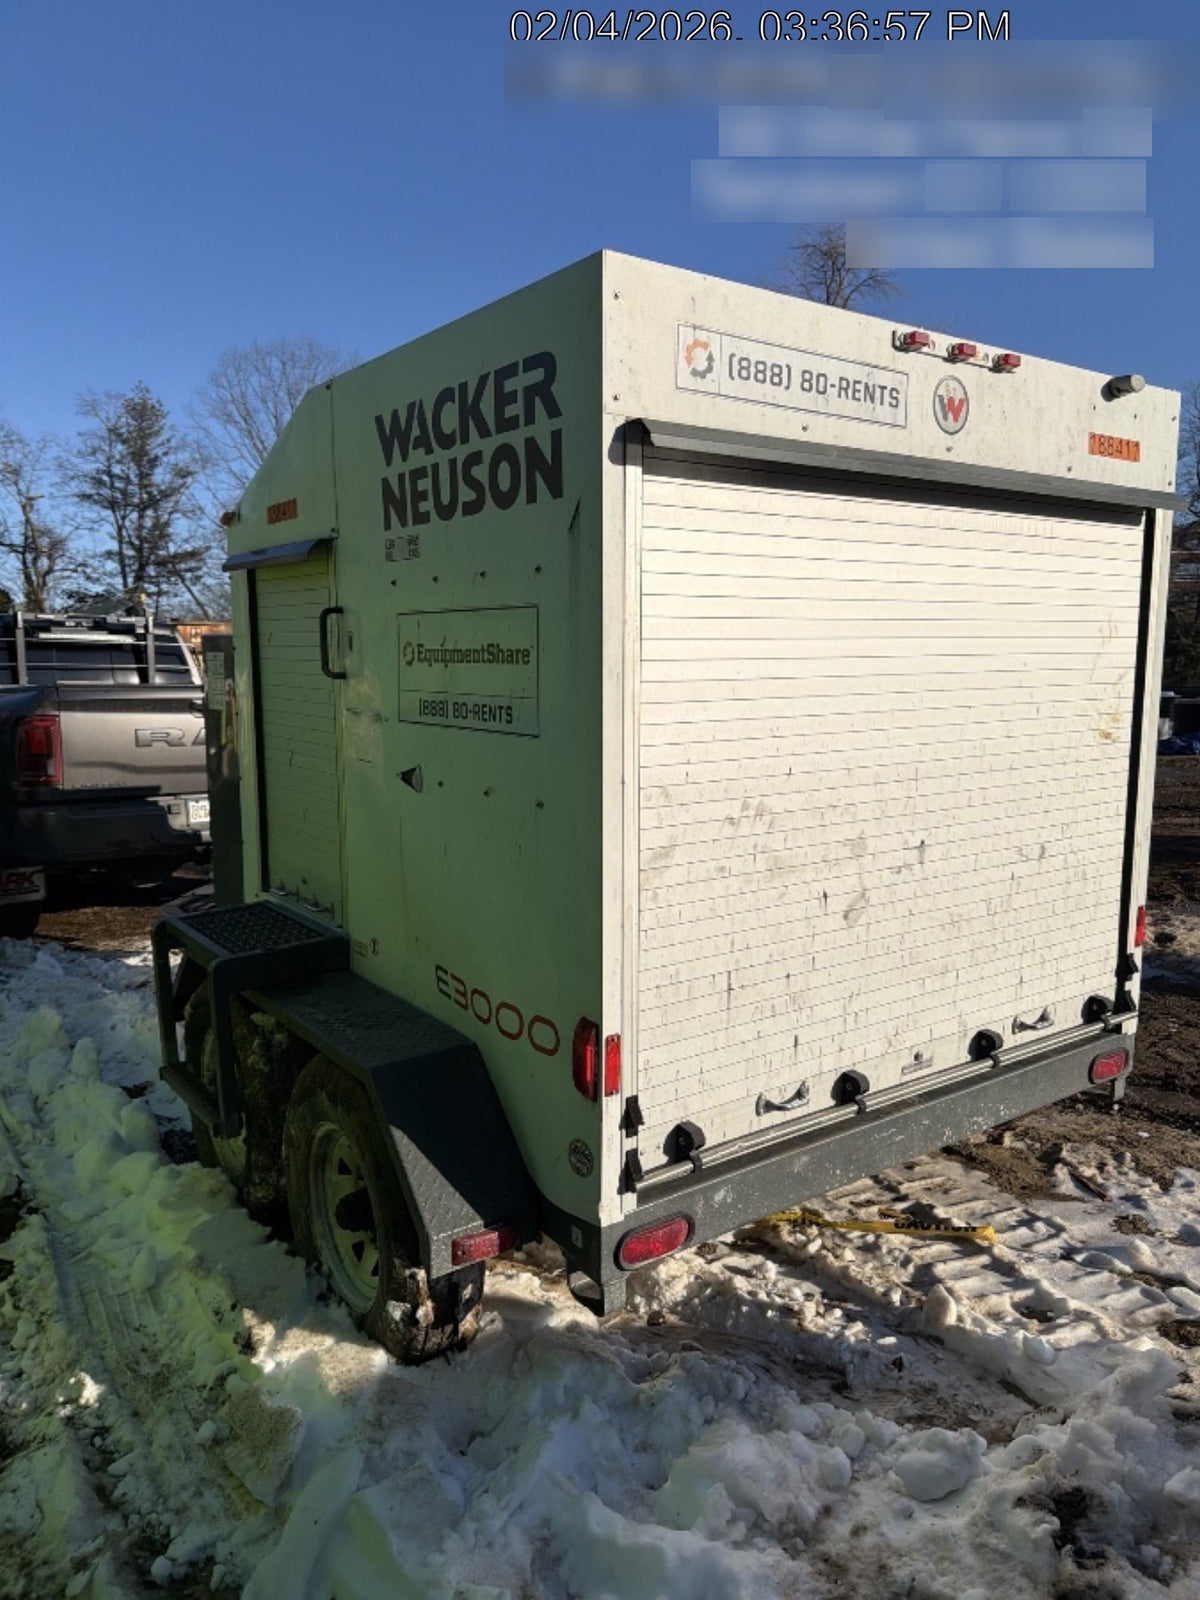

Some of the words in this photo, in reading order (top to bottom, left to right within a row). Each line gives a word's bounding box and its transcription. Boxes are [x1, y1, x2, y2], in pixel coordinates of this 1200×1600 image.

[374, 351, 563, 467] WACKER
[728, 353, 792, 391] (888)
[800, 369, 900, 408] 80-RENTS
[381, 428, 564, 532] NEUSON
[417, 643, 531, 668] EquipmentShare
[453, 702, 513, 724] 80-RENTS
[435, 964, 560, 1057] E3000
